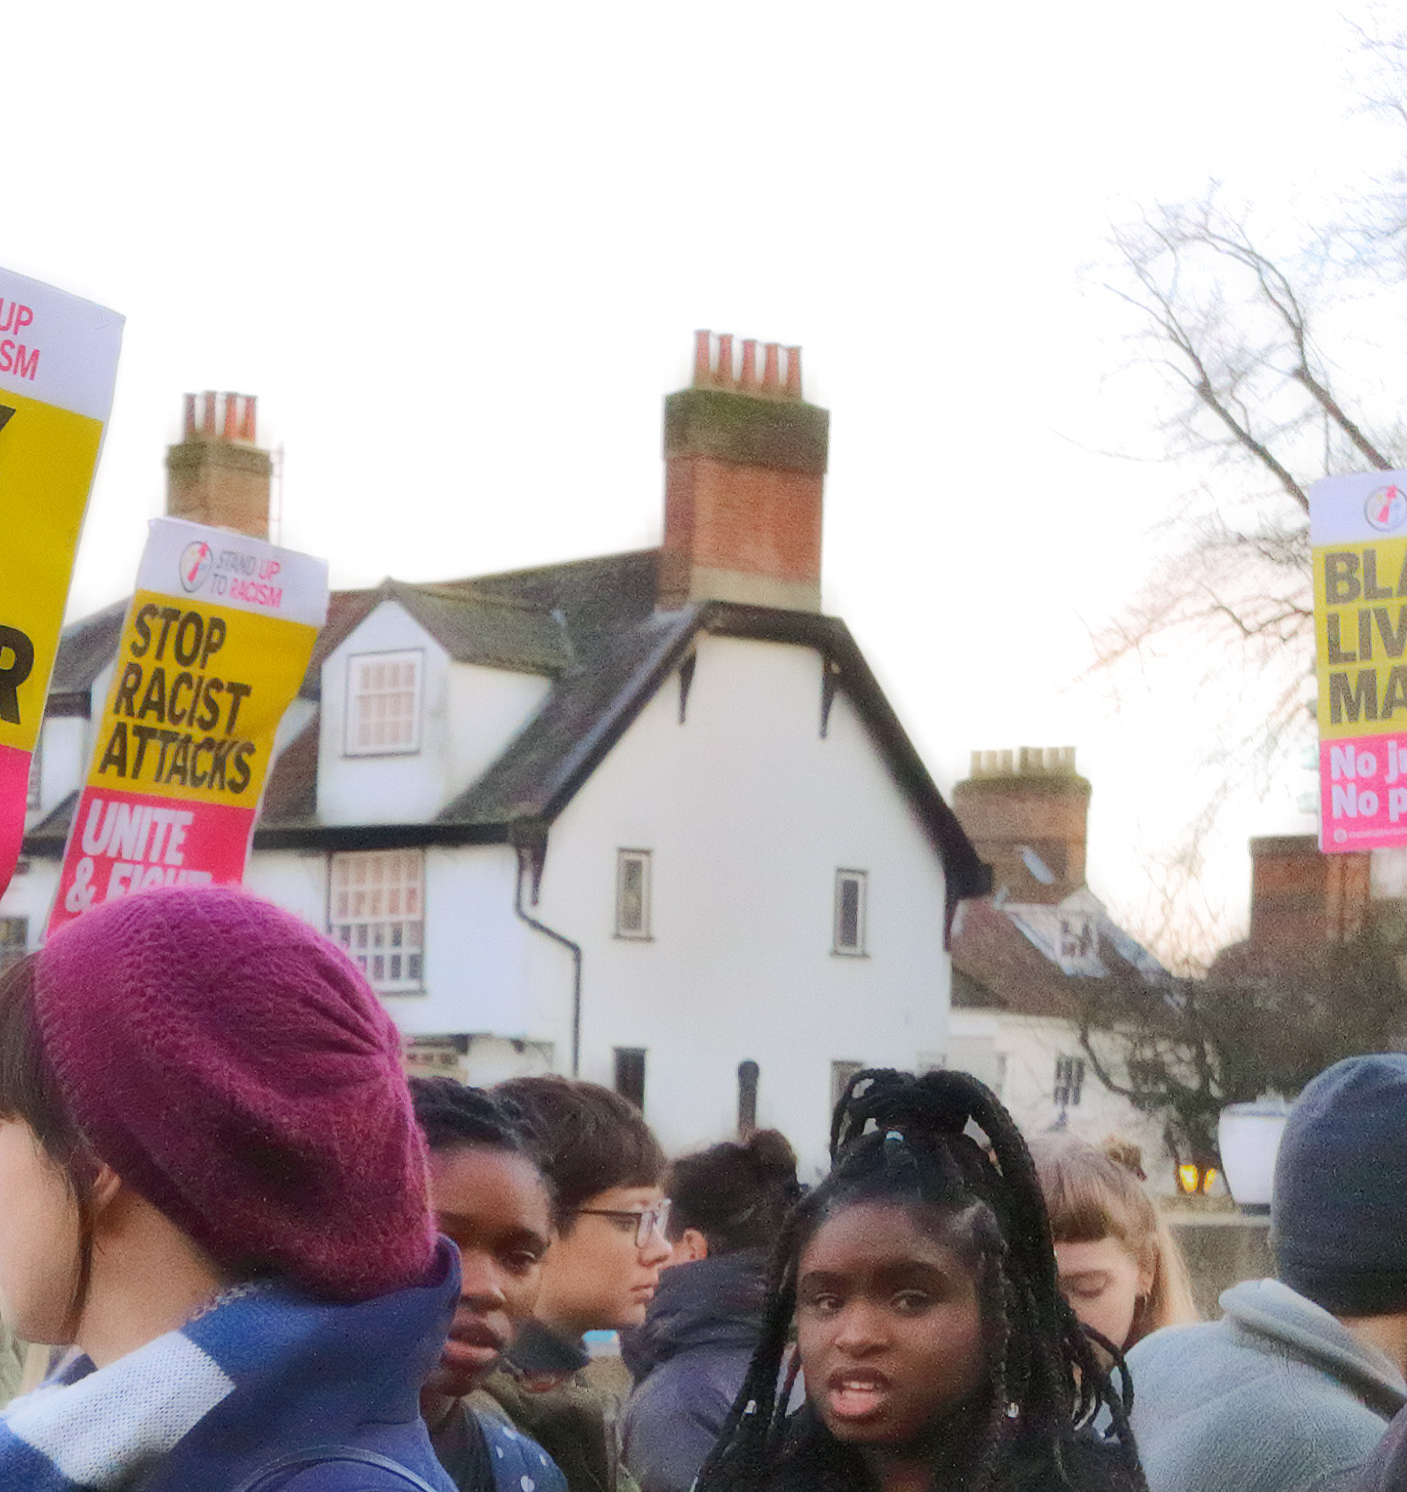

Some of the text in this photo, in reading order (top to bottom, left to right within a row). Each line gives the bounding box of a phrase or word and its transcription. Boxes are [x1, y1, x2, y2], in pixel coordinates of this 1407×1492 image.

[211, 572, 283, 608] TO RACISM
[216, 550, 281, 580] STAND UP
[129, 604, 227, 669] STOP
[113, 662, 252, 734] RACIST
[98, 722, 256, 794] ATTACKS
[1330, 745, 1376, 780] No
[1331, 784, 1378, 819] No
[81, 799, 194, 866] UNITE
[65, 857, 96, 912] &
